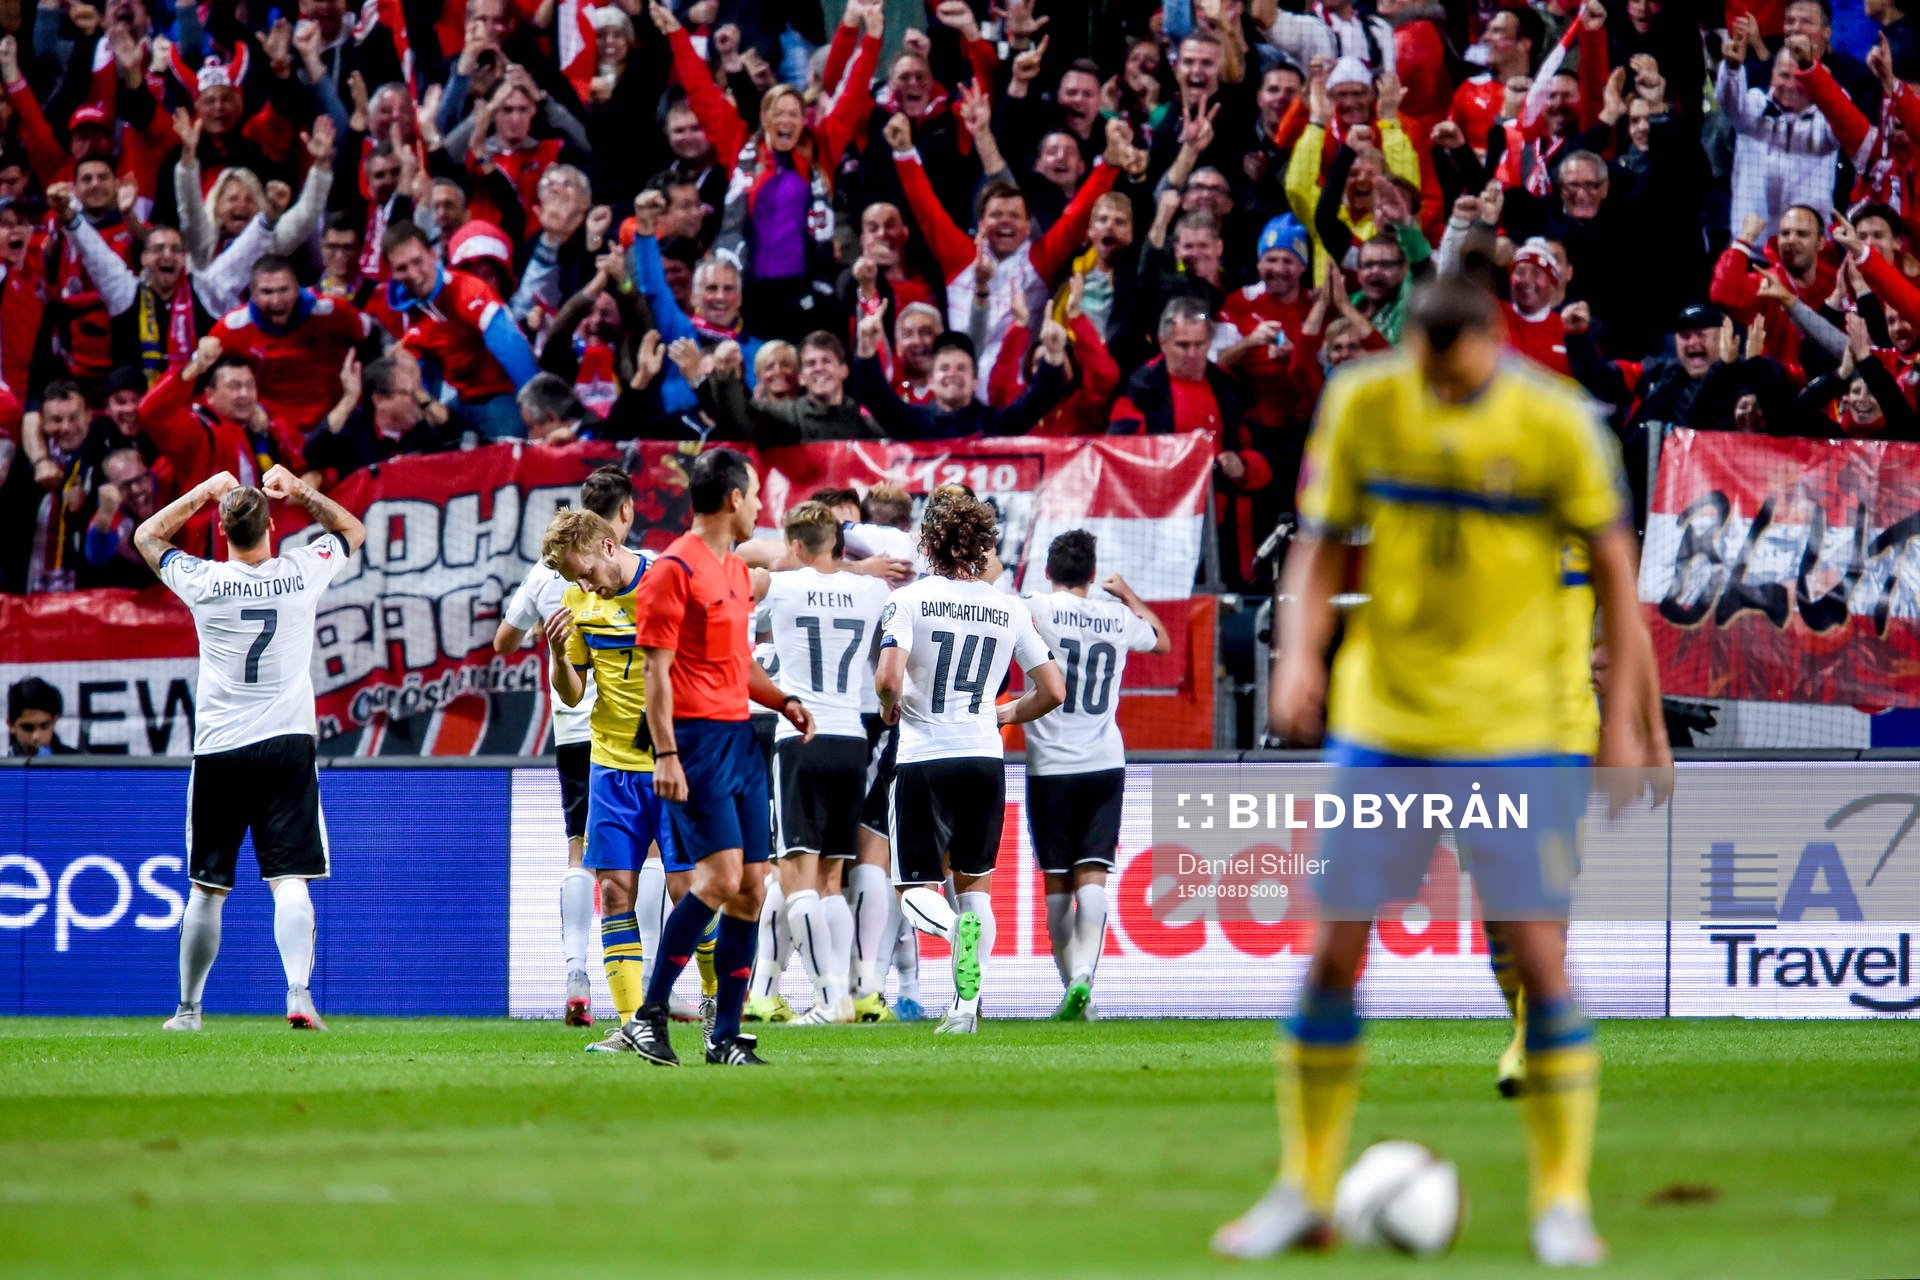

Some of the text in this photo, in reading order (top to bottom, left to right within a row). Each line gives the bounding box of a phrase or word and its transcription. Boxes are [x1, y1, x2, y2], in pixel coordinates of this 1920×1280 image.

[807, 590, 854, 608] KLEIN
[921, 600, 1009, 628] BAUMGARTLINGER
[240, 608, 278, 684] 7
[619, 648, 633, 680] 7
[795, 616, 865, 694] 17
[931, 630, 997, 714] 14
[1059, 637, 1117, 715] 10
[1708, 841, 1865, 922] LA
[1710, 932, 1910, 987] Travel
